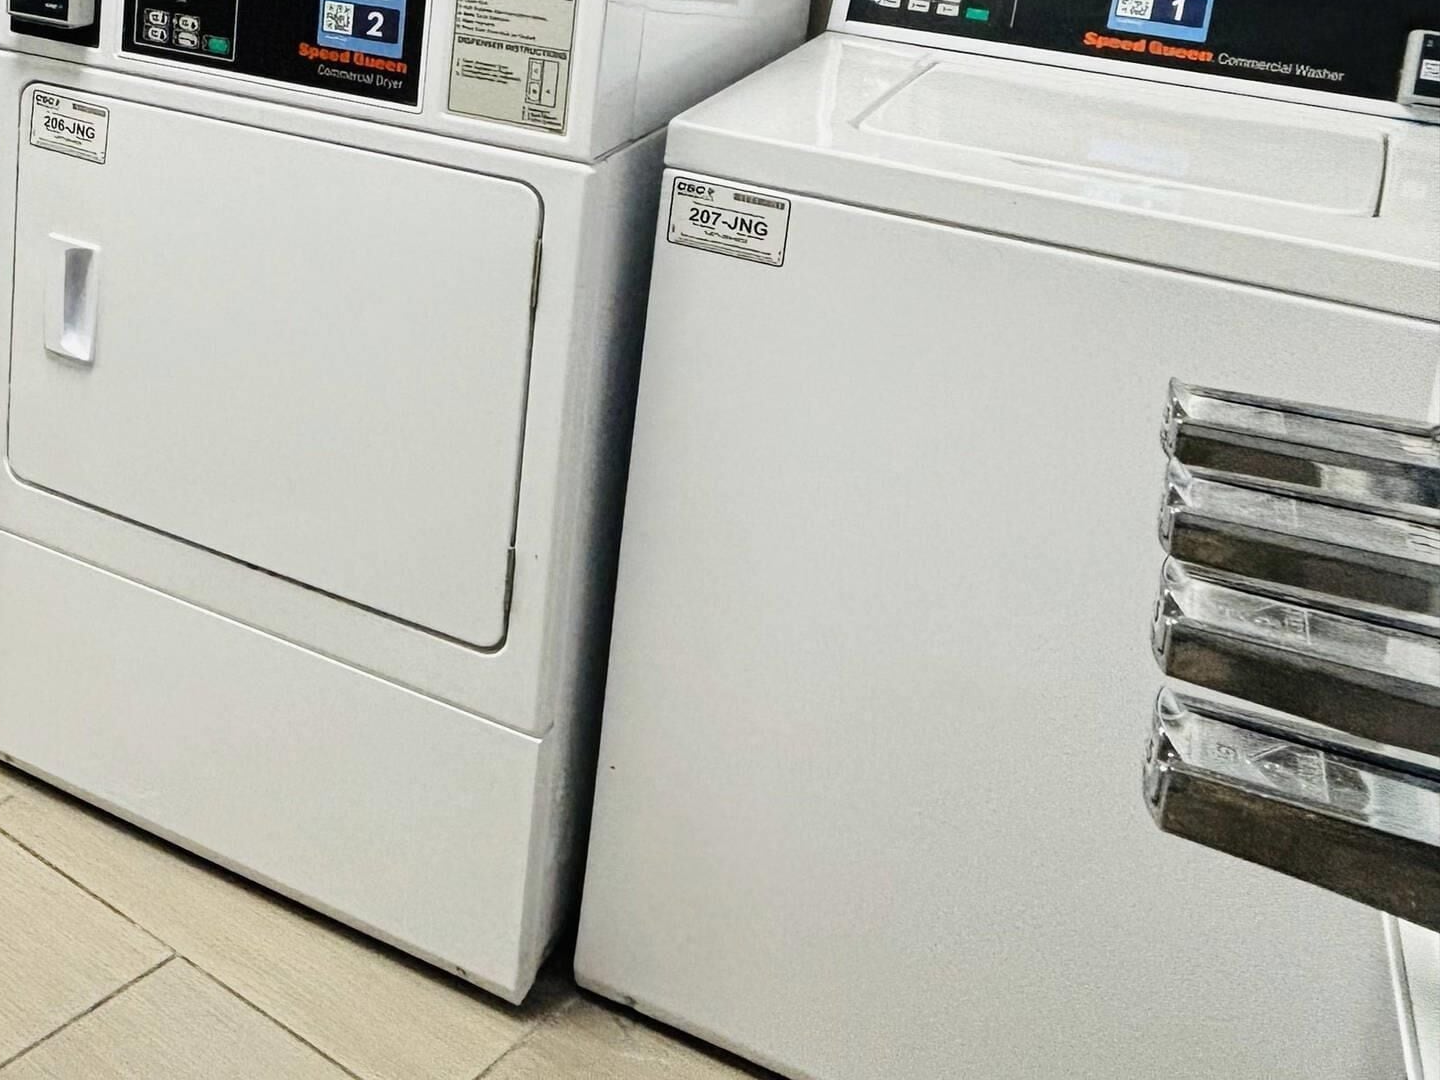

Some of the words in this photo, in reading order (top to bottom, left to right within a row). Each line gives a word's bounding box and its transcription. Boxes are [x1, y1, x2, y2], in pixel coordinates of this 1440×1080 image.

[366, 11, 384, 37] 2
[298, 42, 351, 64] Speed
[353, 50, 408, 74] Queen
[1082, 30, 1147, 53] Speed
[1149, 40, 1214, 63] Queen
[1217, 51, 1292, 74] Commercial
[1295, 62, 1345, 82] Washer
[317, 63, 374, 84] Commercial
[375, 74, 403, 89] Dryer
[43, 115, 96, 139] 206-JNG
[688, 207, 769, 237] 207-JNG
